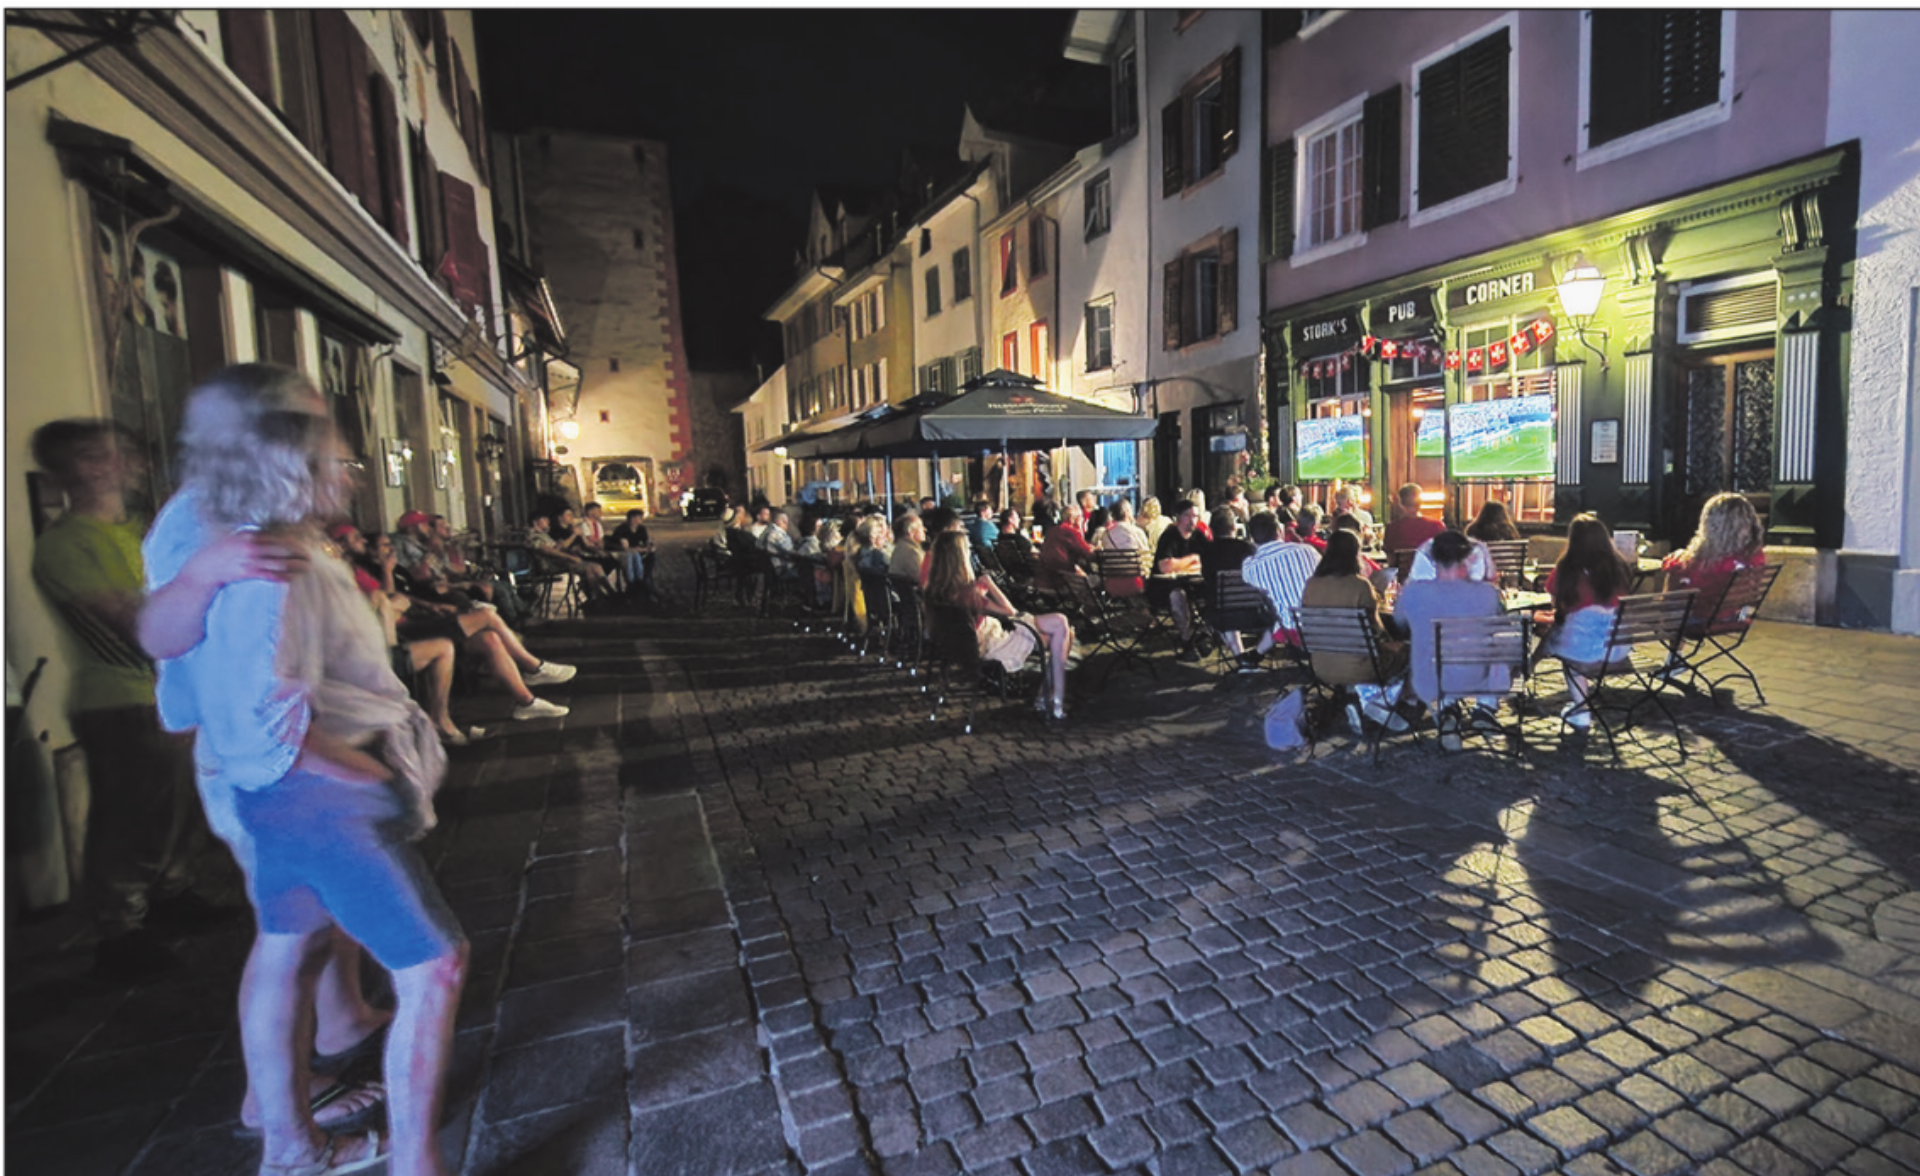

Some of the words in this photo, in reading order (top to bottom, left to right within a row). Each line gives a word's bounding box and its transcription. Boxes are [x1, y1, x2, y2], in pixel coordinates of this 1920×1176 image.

[1302, 318, 1348, 342] STORK'S
[1388, 301, 1416, 323] PUB
[1466, 271, 1534, 306] CORNER
